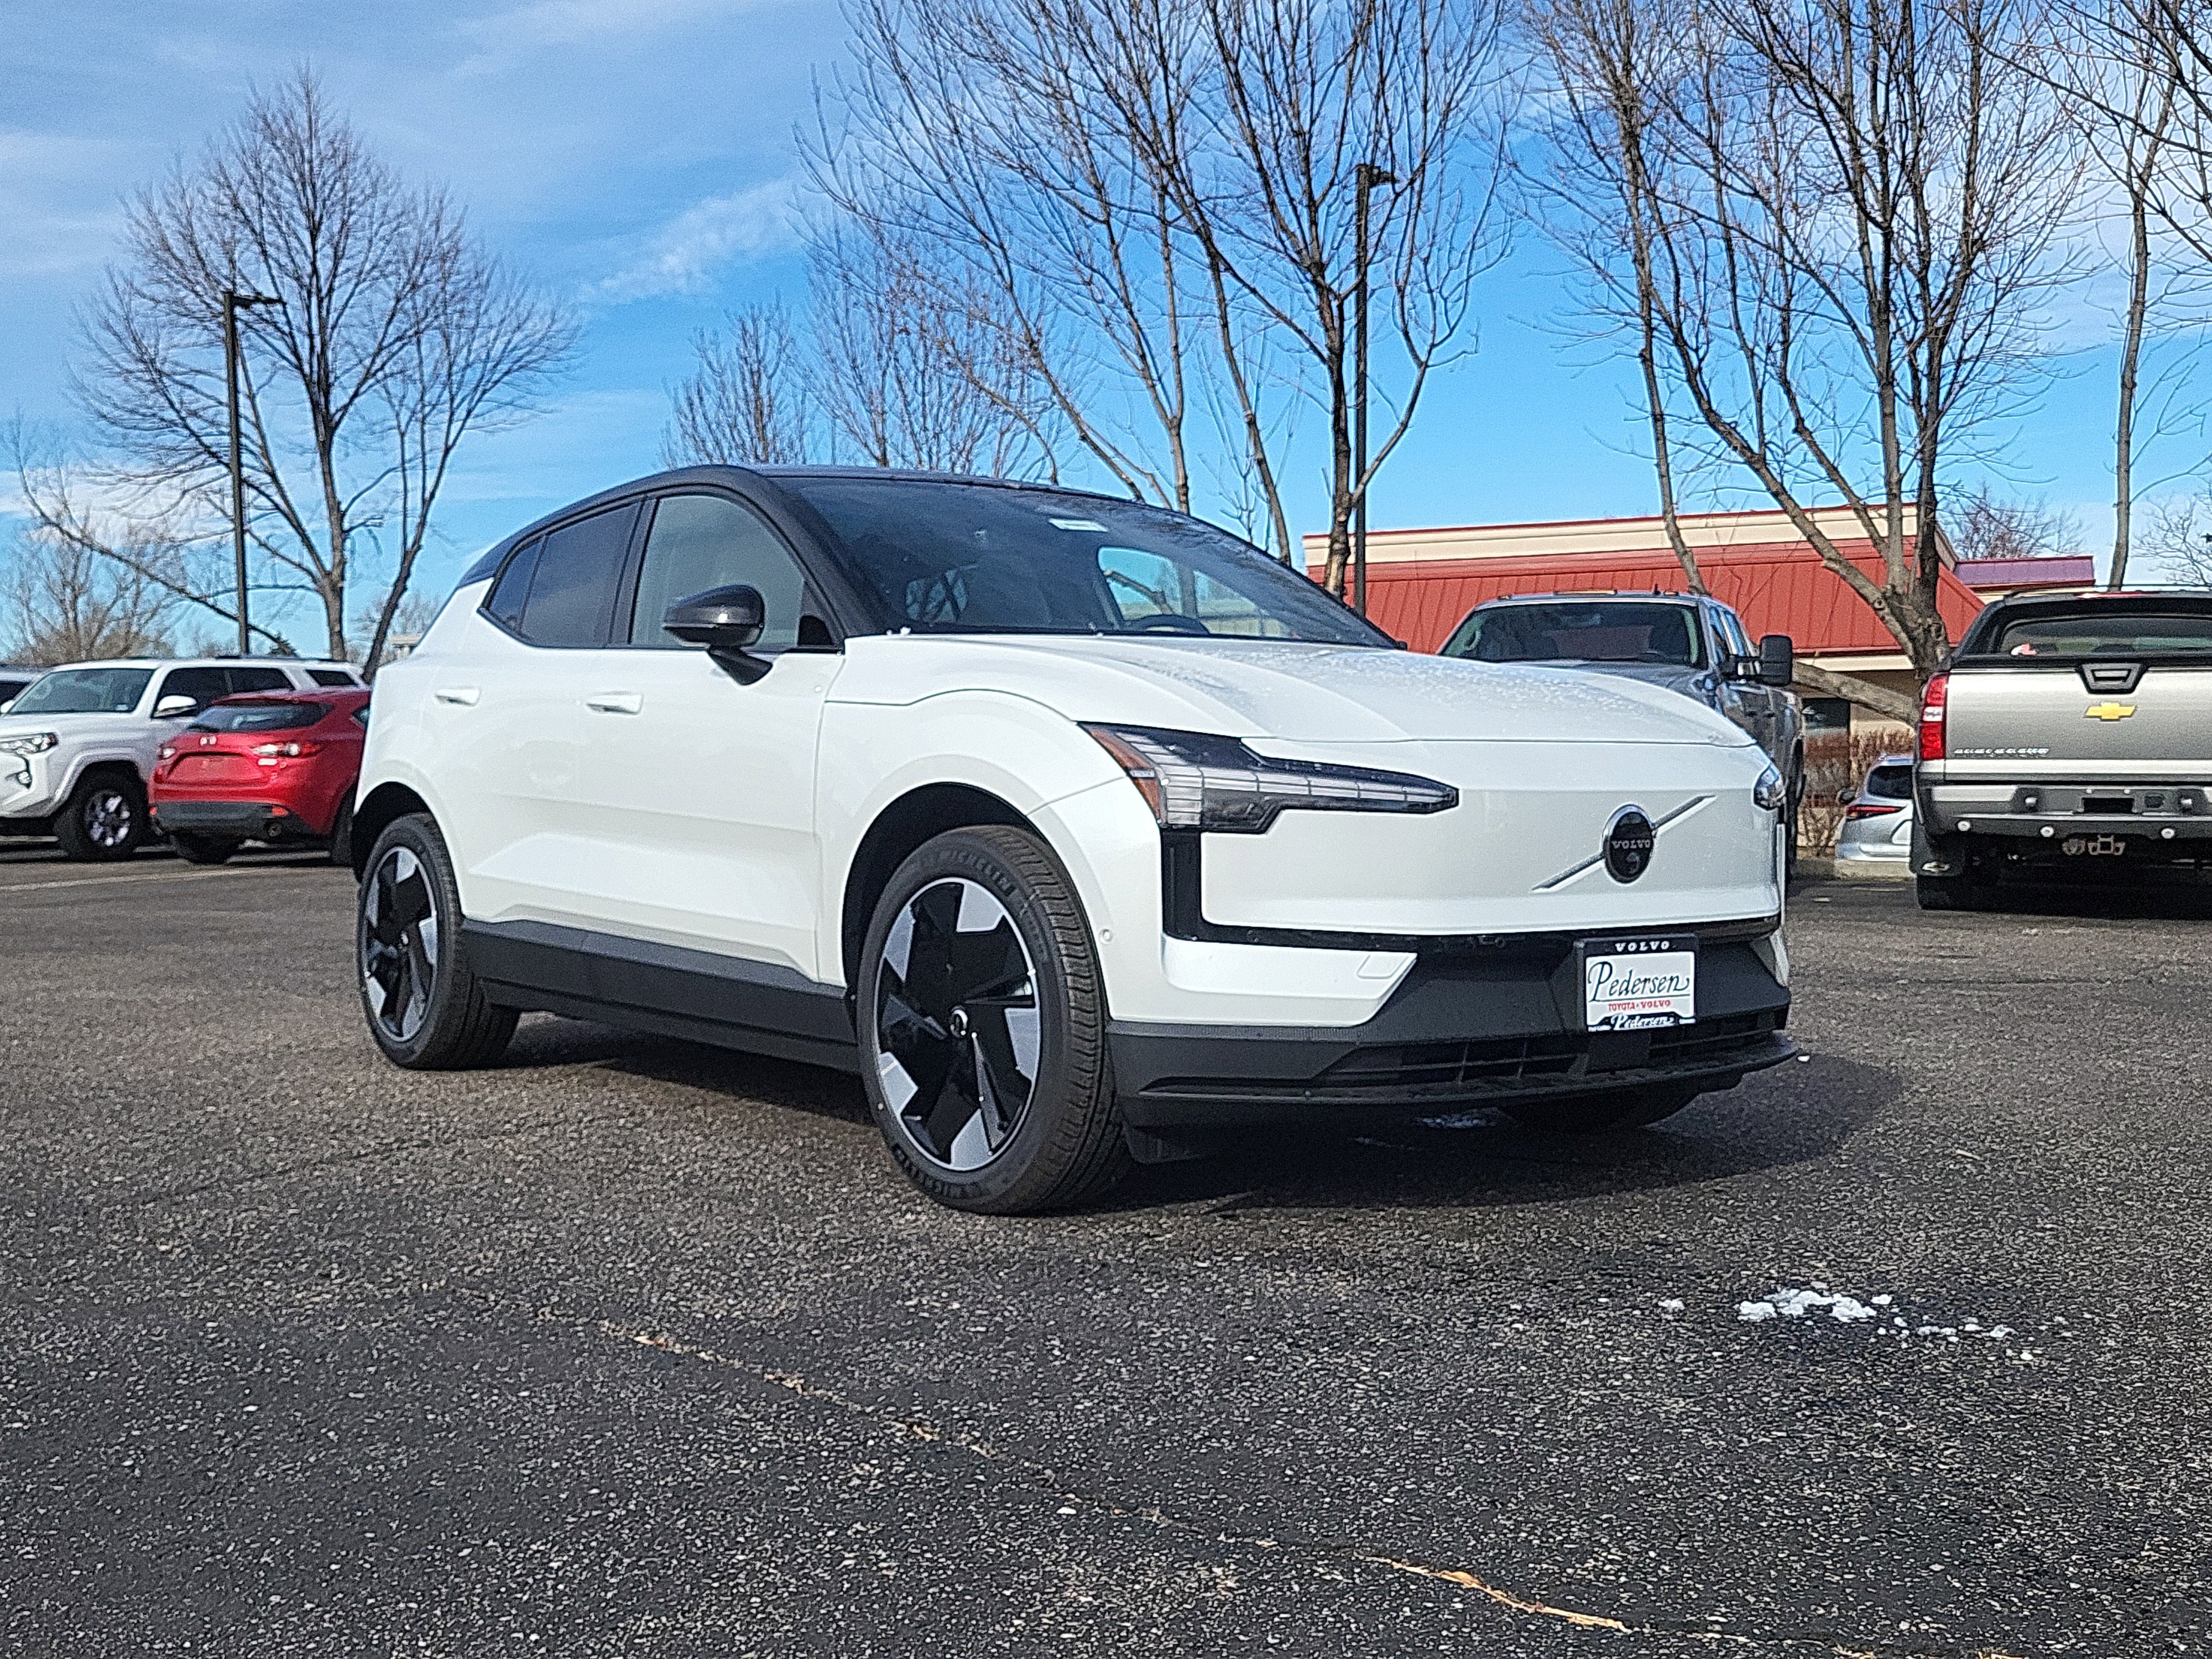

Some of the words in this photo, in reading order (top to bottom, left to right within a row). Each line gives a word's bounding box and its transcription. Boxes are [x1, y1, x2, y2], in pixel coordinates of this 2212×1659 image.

[1611, 839, 1651, 849] VOLVO
[1615, 941, 1670, 952] VOLVO
[1588, 961, 1690, 1003] Pedersen
[1608, 1001, 1635, 1011] TOYOTA
[1641, 999, 1671, 1009] VOLVO
[1610, 1014, 1676, 1031] Pedersen
